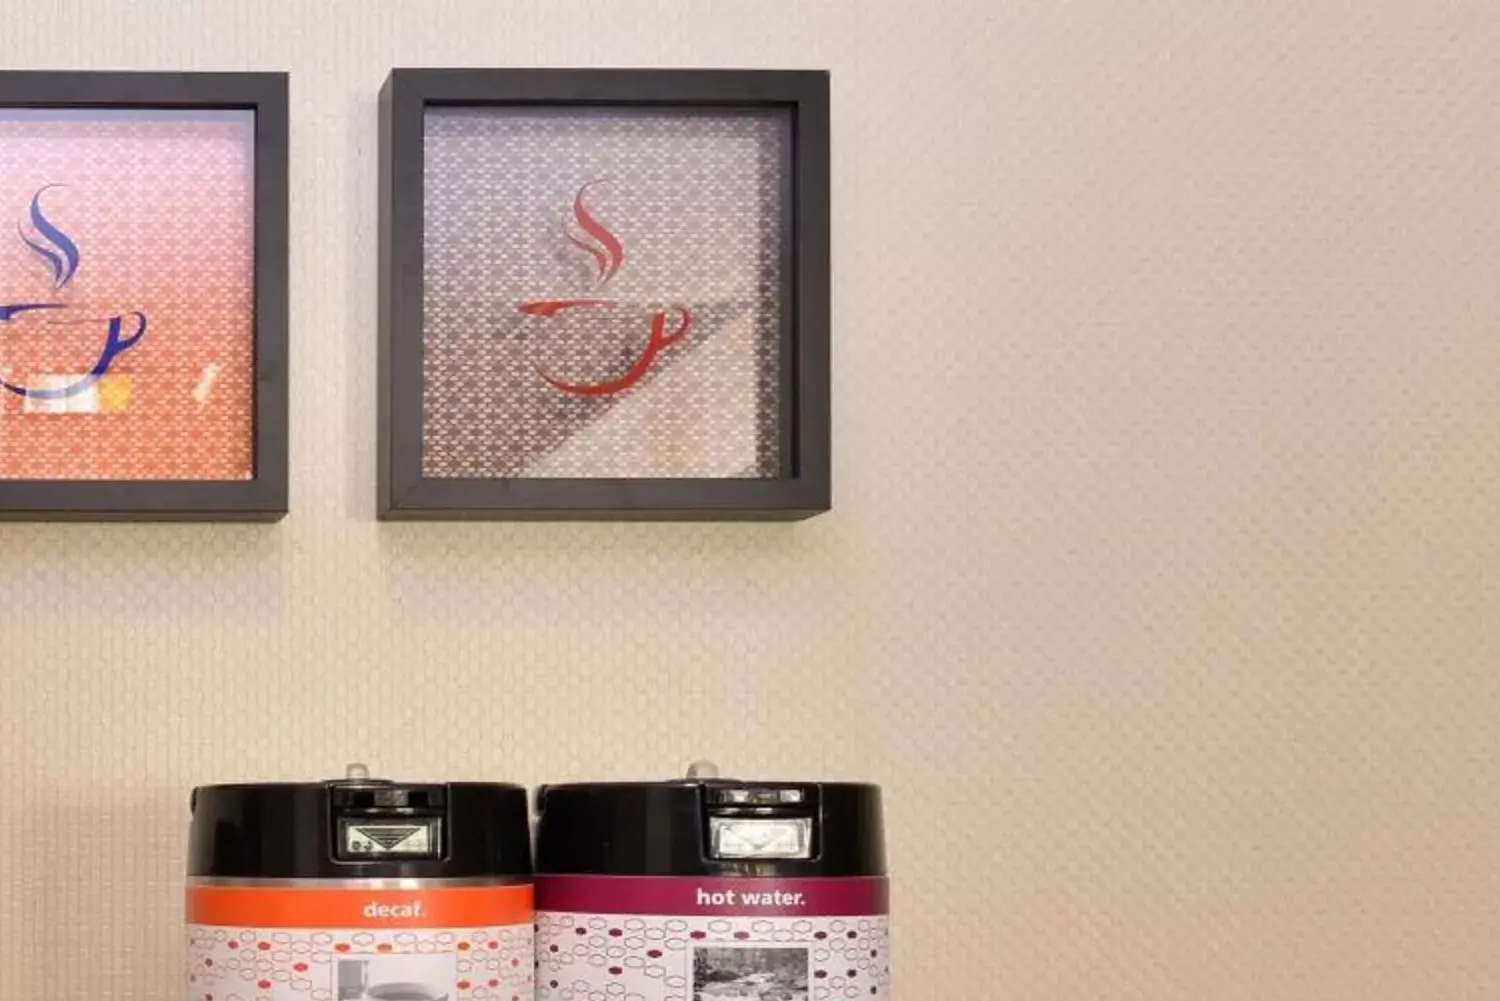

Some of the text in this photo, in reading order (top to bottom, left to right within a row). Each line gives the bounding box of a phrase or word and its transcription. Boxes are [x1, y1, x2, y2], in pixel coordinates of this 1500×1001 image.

[696, 887, 806, 906] hot water.
[363, 900, 427, 918] decaf.
